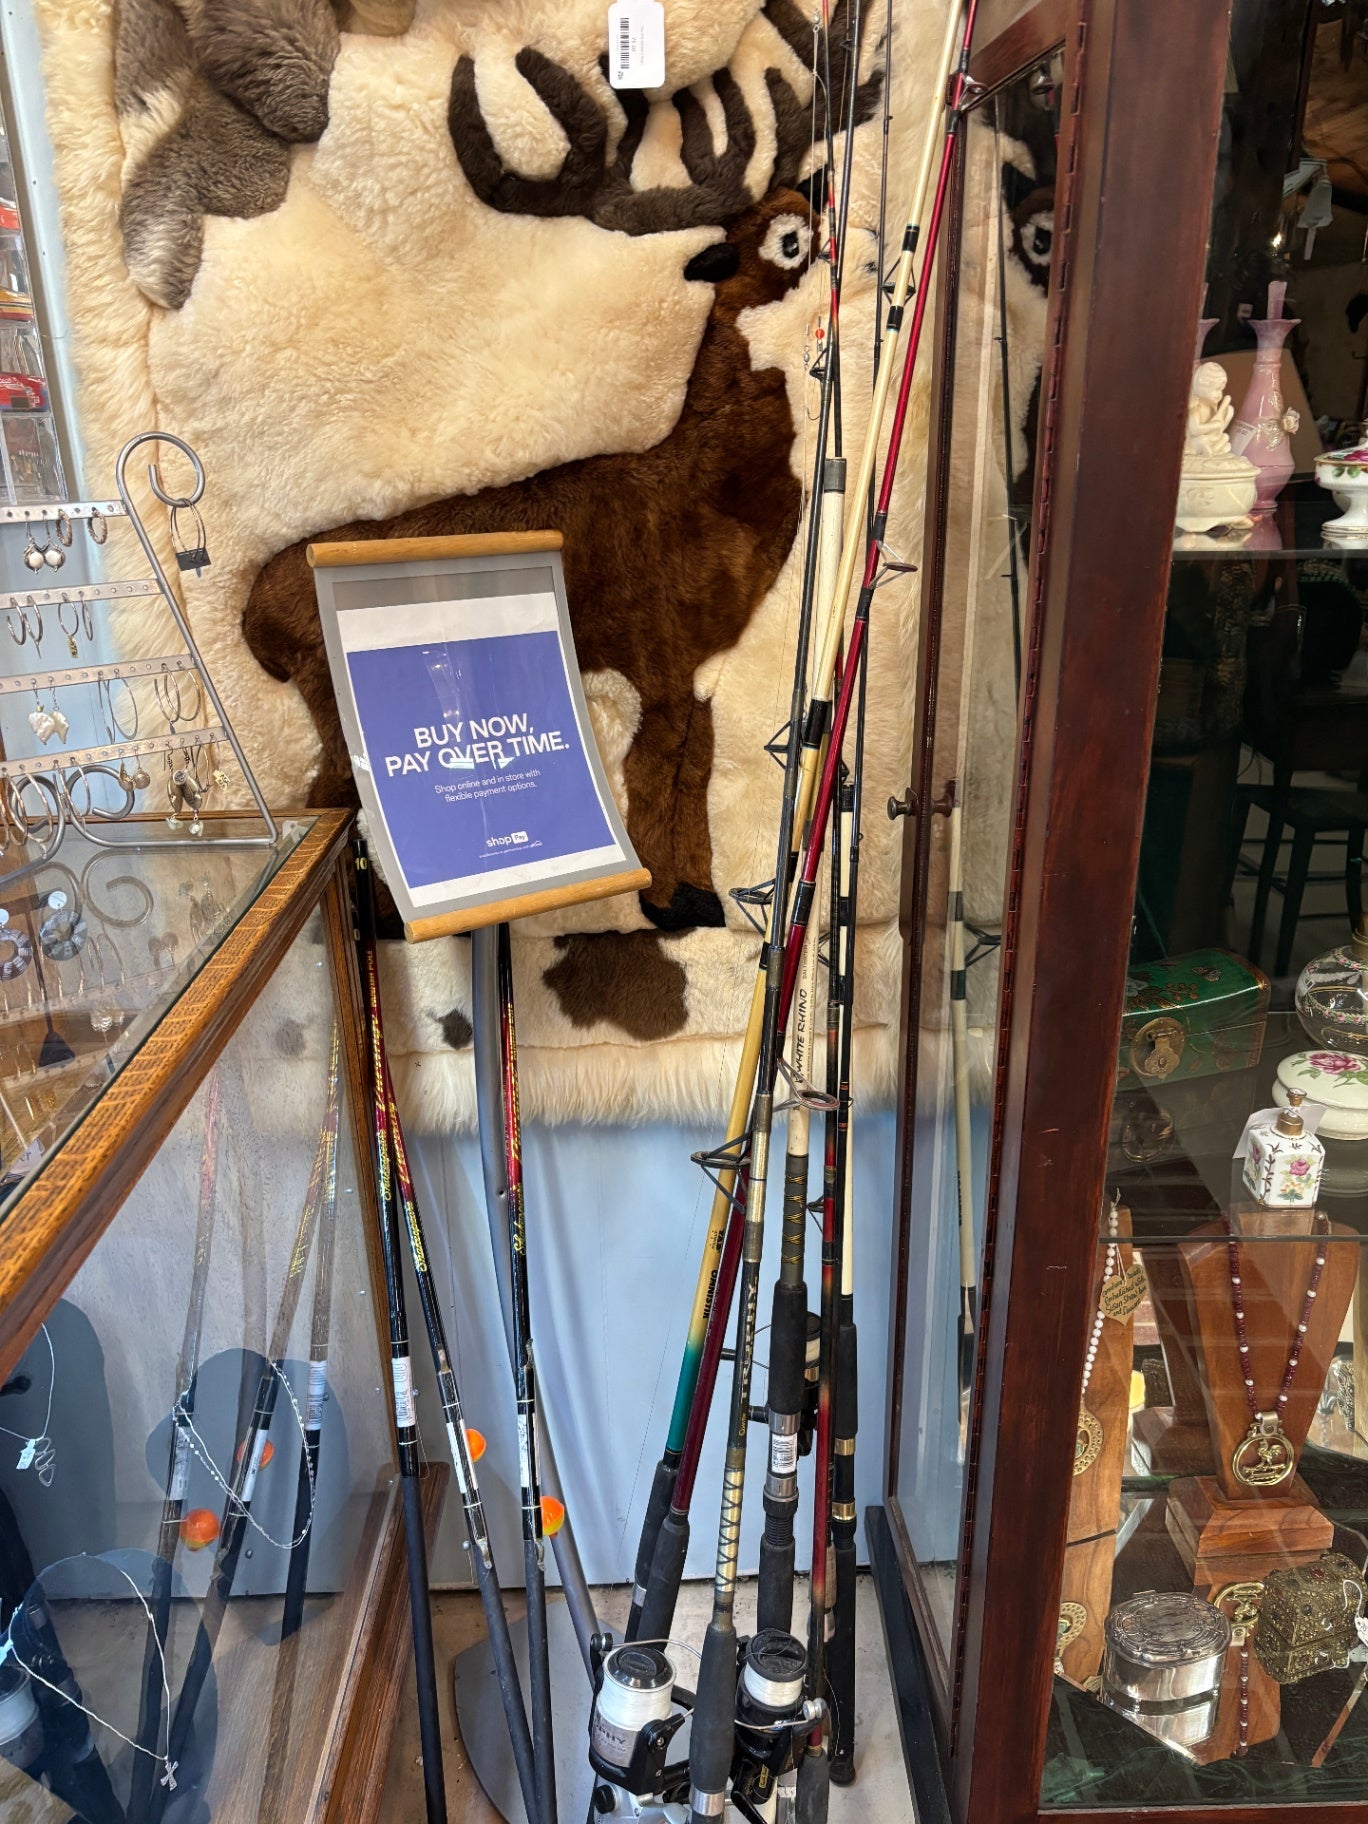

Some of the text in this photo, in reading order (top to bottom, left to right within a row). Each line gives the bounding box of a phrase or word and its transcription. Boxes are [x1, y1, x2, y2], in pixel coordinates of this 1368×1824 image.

[413, 712, 534, 749] BUY NOW,
[384, 731, 570, 778] PAY OVER TIME.
[434, 768, 541, 795] Shop online and in store with
[445, 781, 538, 803] flexible payment options.
[486, 836, 512, 848] shop
[355, 857, 368, 871] 10
[795, 988, 808, 1074] WHITE RHINO
